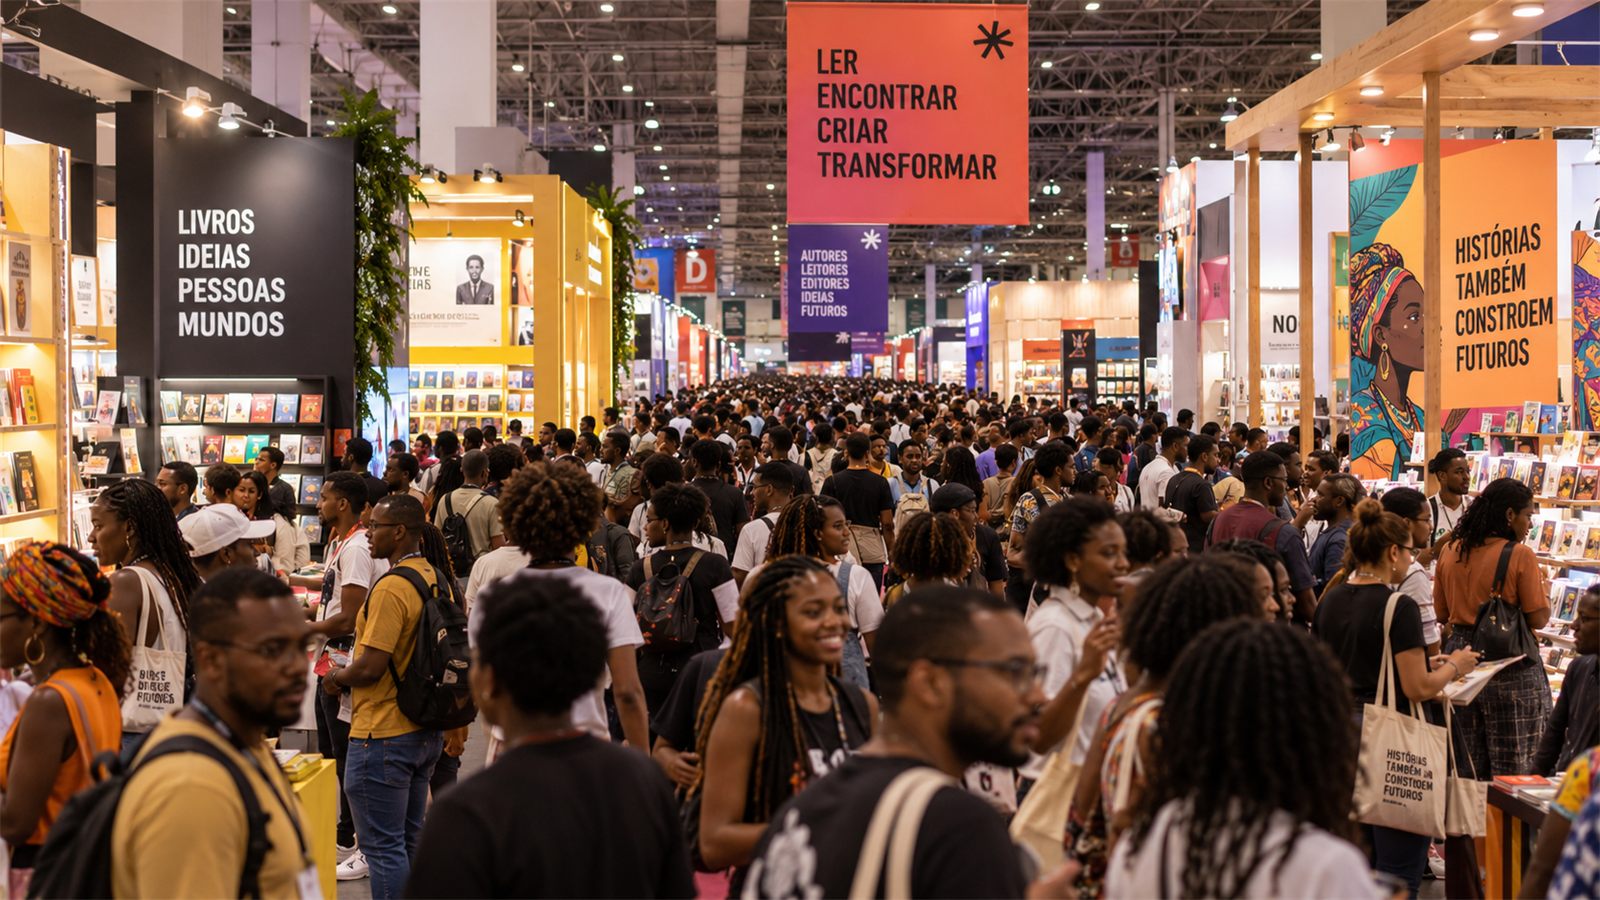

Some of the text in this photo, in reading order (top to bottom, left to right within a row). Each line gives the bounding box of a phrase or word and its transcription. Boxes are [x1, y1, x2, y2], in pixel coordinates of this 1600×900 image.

[817, 48, 858, 75] LER
[817, 82, 957, 111] ENCONTRAR
[817, 116, 888, 144] CRIAR
[817, 151, 997, 180] TRANSFORMAR
[178, 208, 255, 235] LIVROS
[178, 242, 251, 269] IDEIAS
[800, 249, 848, 262] AUTORES
[1455, 223, 1541, 264] HISTÓRIAS
[685, 256, 707, 284] D
[800, 263, 849, 276] LEITORES
[1455, 259, 1527, 300] TAMBÉM
[178, 277, 286, 303] PESSOAS
[800, 277, 850, 290] EDITORES
[800, 290, 835, 303] IDEIAS
[178, 311, 285, 337] MUNDOS
[800, 304, 848, 317] FUTUROS
[1272, 314, 1300, 334] NO
[1455, 297, 1553, 336] CONSTROEM
[1455, 338, 1530, 372] FUTUROS
[1383, 785, 1423, 802] FUTUROS
